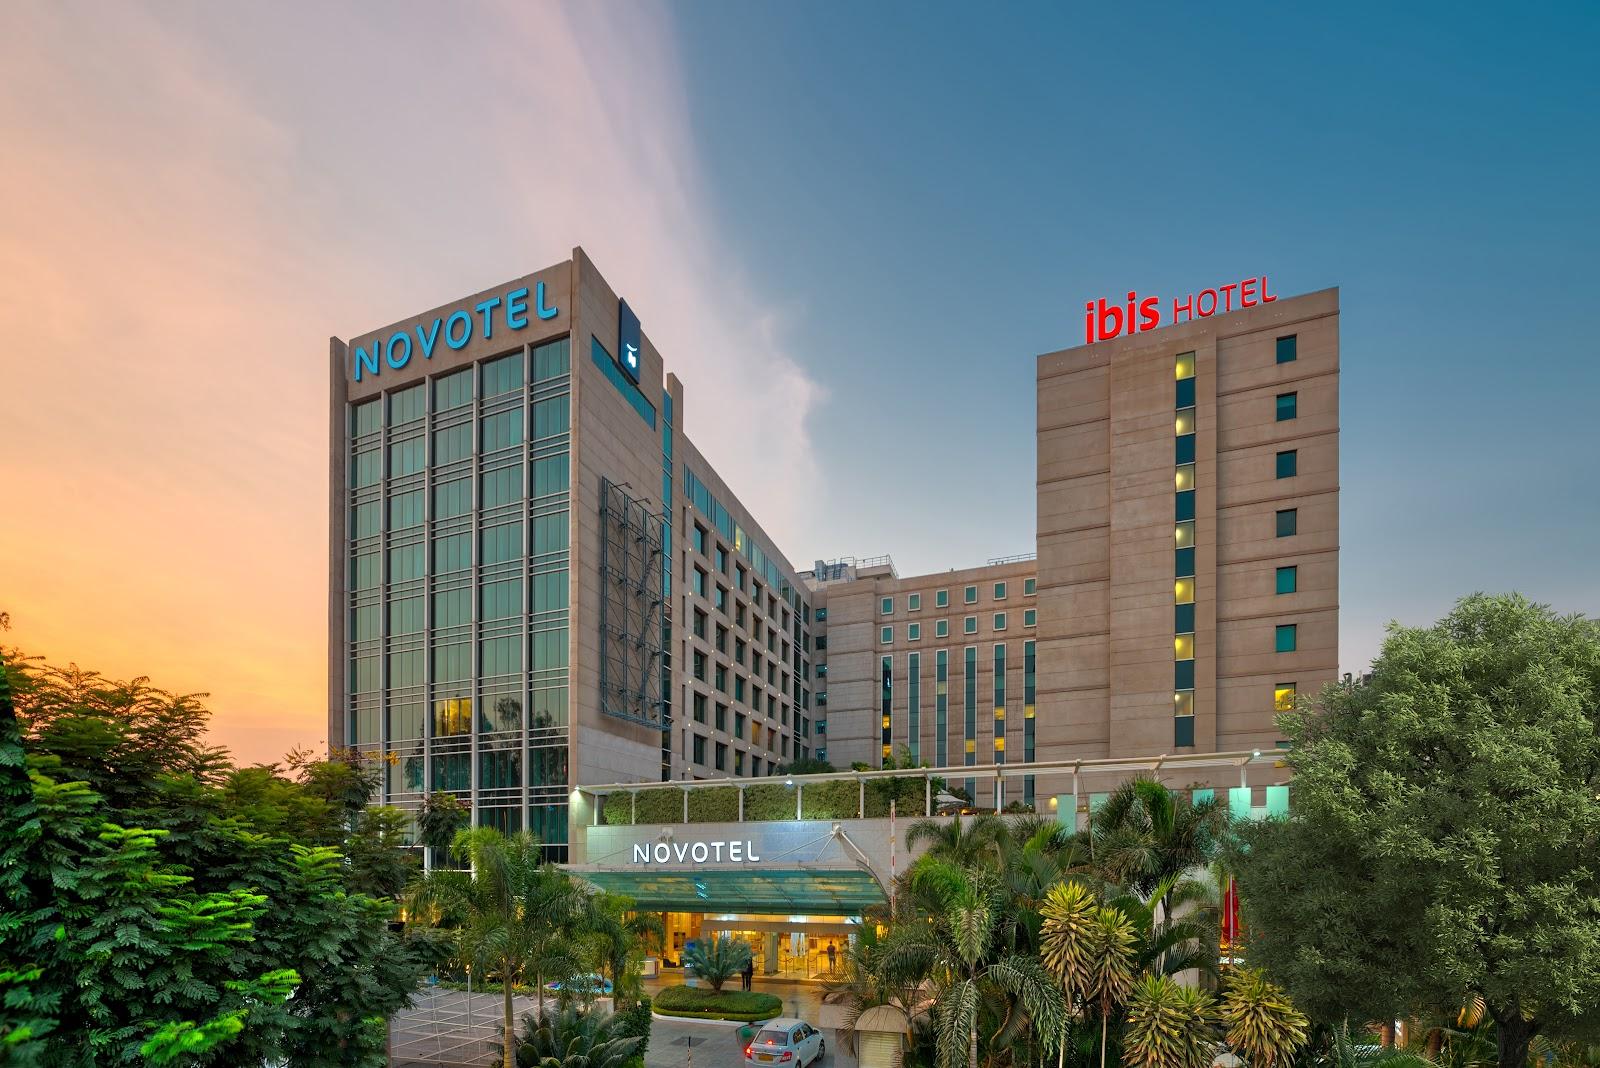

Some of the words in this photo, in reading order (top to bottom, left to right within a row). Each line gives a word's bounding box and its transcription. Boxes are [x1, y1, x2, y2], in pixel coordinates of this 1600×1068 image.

[354, 280, 559, 382] NOVOTEL
[1085, 290, 1160, 344] ibis
[1173, 275, 1278, 325] HOTEL
[632, 840, 761, 863] NOVOTEL
